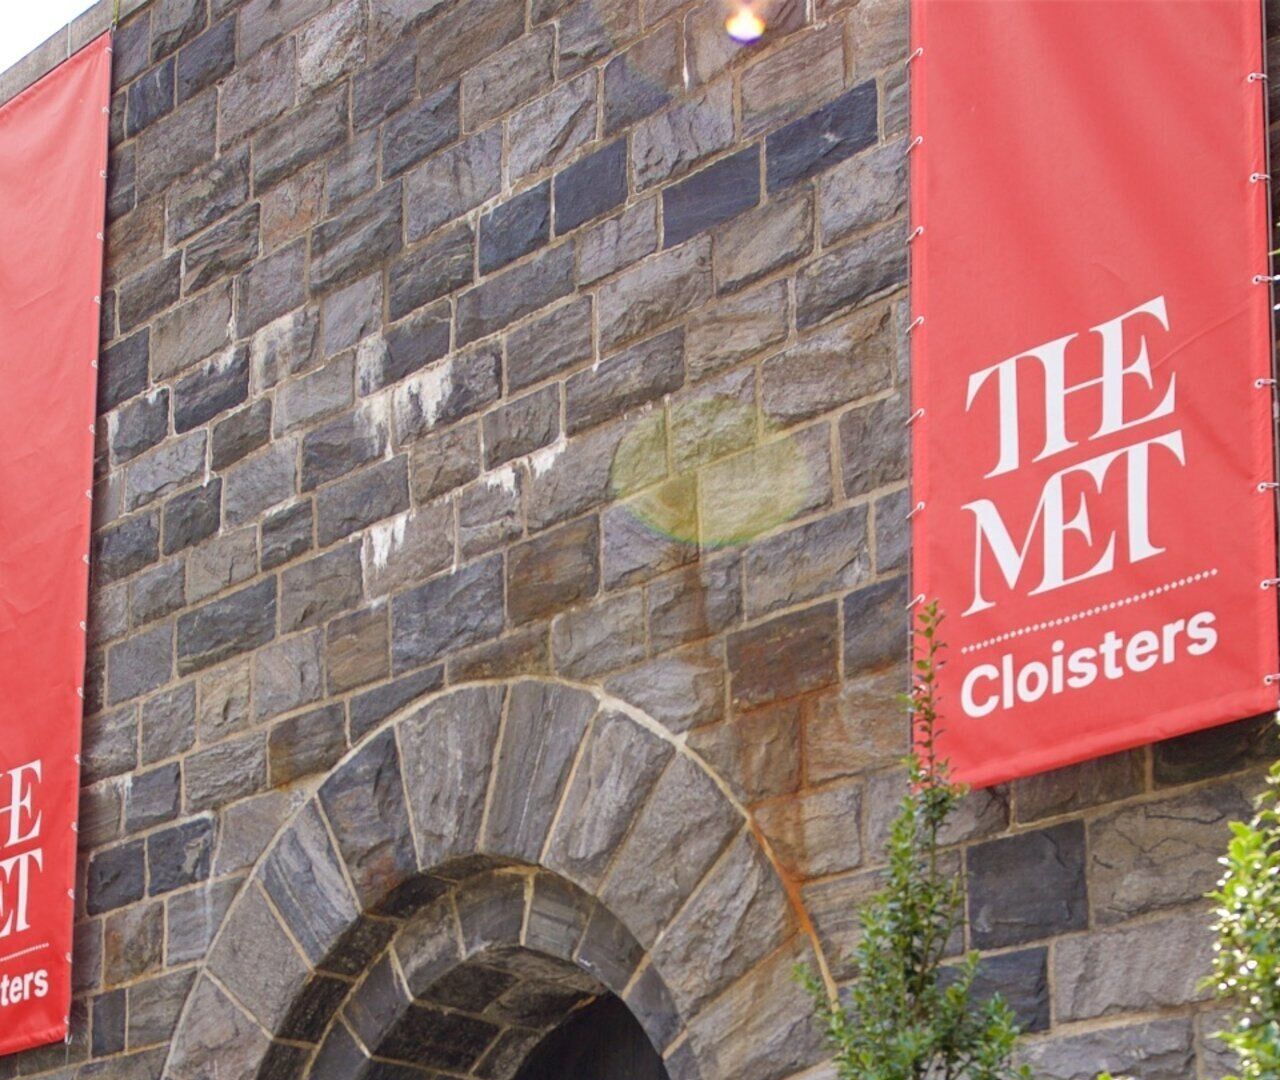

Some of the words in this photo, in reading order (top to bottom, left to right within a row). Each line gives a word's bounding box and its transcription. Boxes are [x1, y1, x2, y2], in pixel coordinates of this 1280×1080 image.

[965, 295, 1177, 479] THE
[960, 429, 1187, 617] MET
[960, 611, 1218, 718] Cloisters
